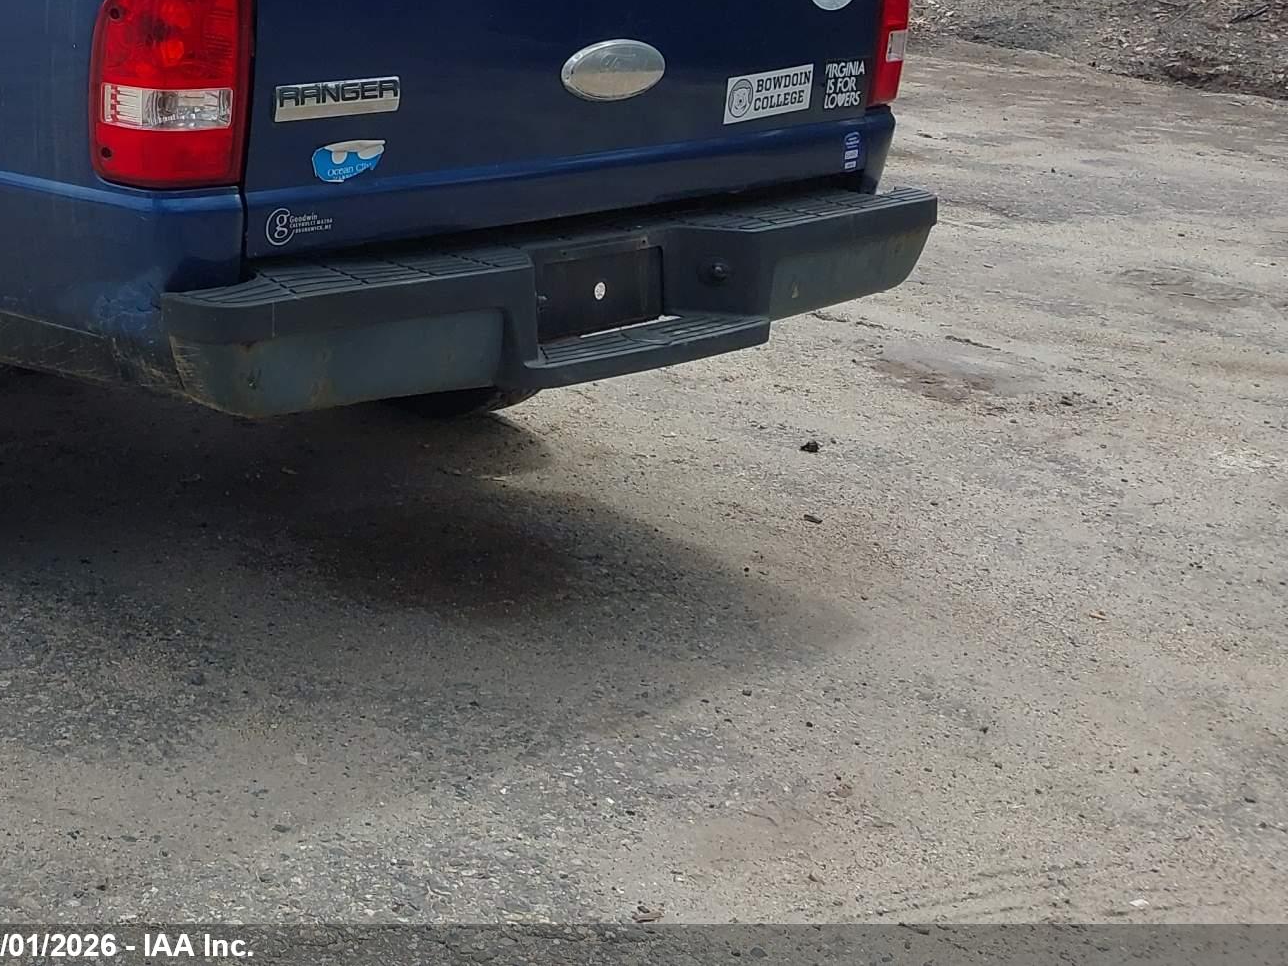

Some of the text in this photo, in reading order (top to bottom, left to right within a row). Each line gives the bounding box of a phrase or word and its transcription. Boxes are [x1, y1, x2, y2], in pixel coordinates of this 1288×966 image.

[825, 60, 865, 78] VIRGINIA
[756, 70, 811, 93] BOWDOIN
[826, 77, 857, 93] IS FOR
[278, 80, 399, 107] RANGER
[753, 90, 805, 111] COLLEGE
[327, 166, 354, 177] Ocean
